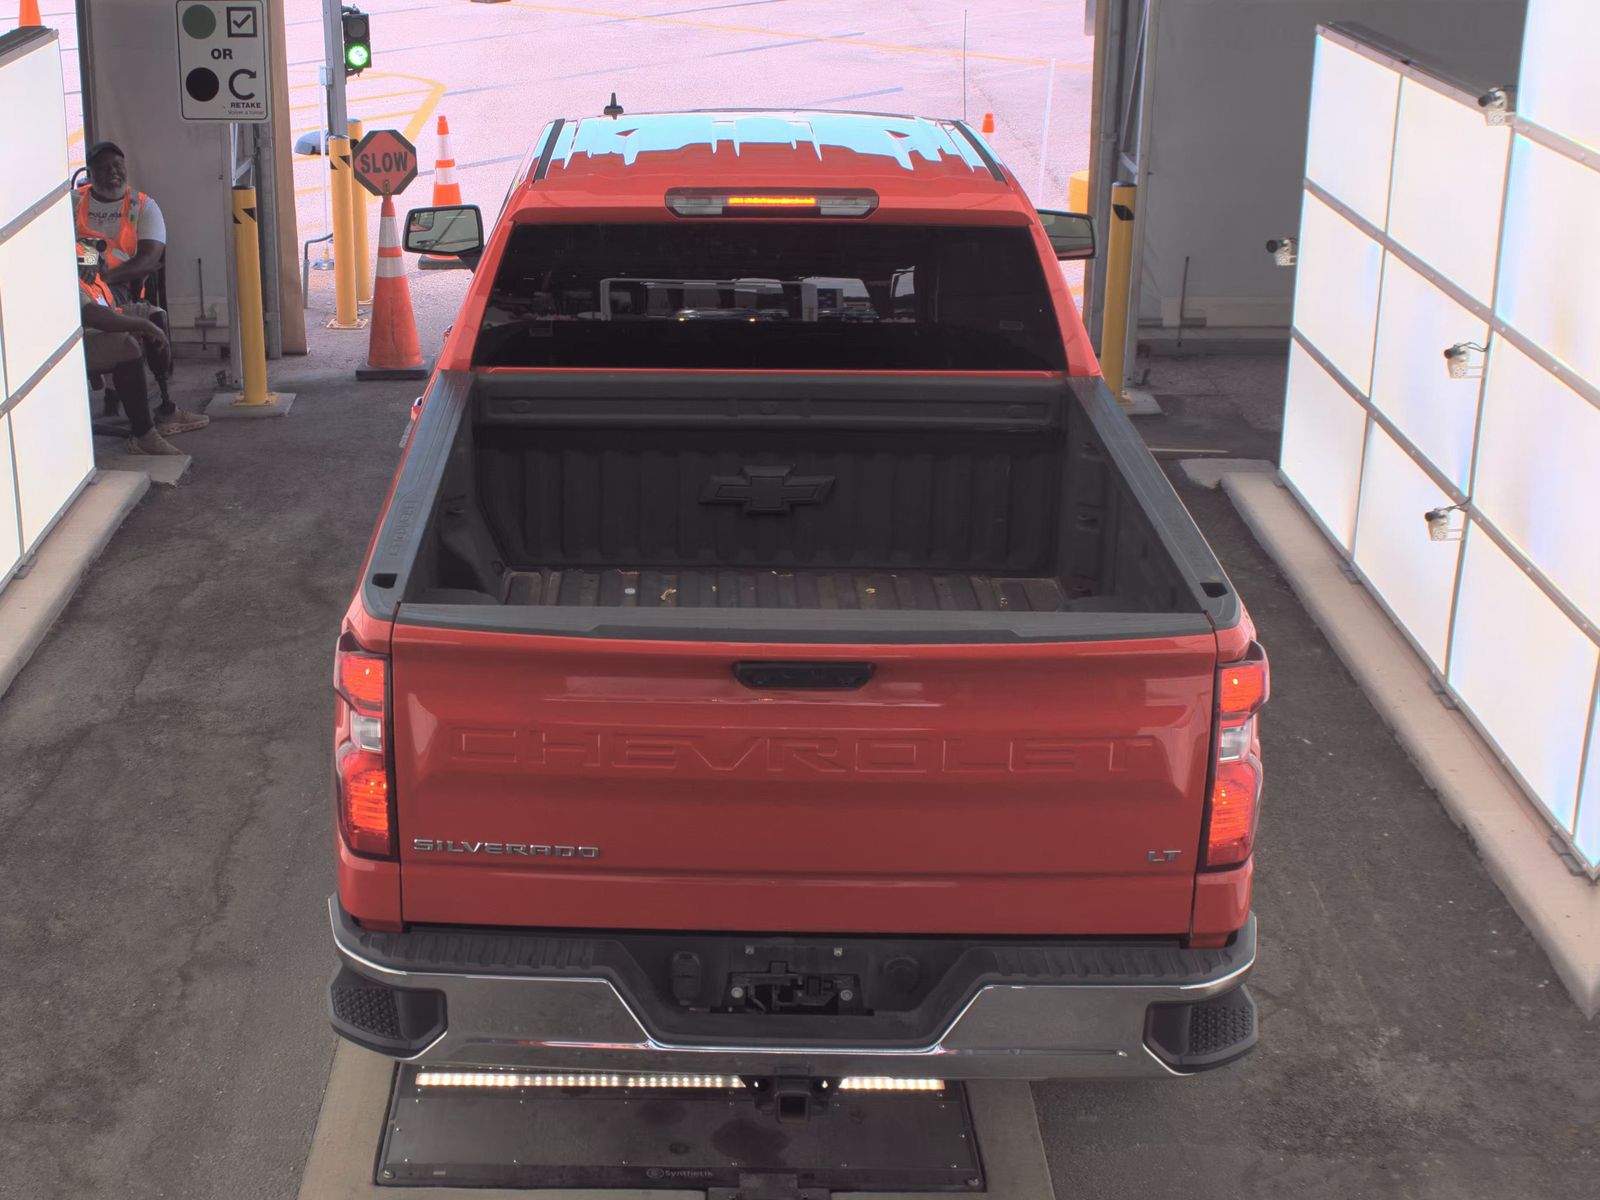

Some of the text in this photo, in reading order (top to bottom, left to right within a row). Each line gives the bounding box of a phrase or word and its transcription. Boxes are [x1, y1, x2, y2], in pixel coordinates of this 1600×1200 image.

[210, 48, 233, 60] OR
[230, 101, 262, 109] RETAKE
[360, 152, 408, 174] SLOW
[451, 726, 1155, 773] CHEVROLET
[413, 838, 599, 859] SILVERADO
[1148, 849, 1182, 863] LT
